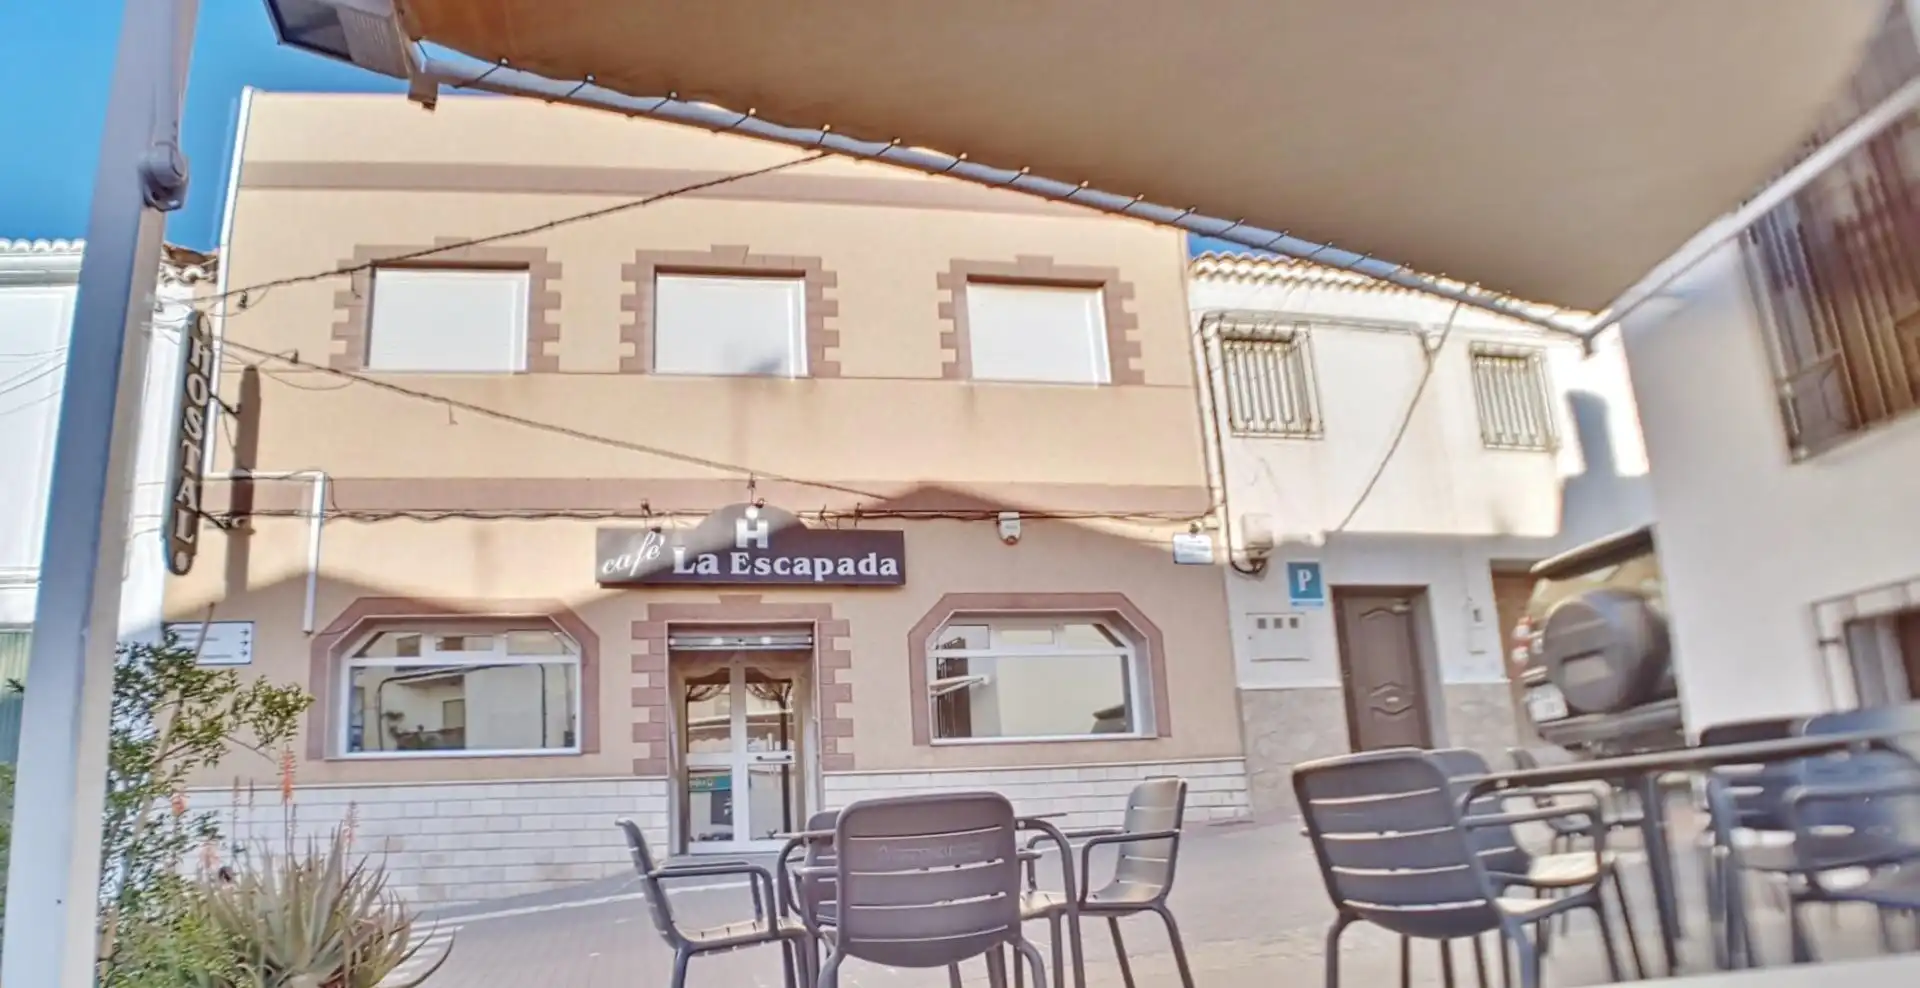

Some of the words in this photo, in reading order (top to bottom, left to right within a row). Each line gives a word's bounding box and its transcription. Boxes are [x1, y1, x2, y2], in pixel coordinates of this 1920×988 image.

[175, 337, 211, 544] HOSTAL
[671, 547, 720, 575] La
[730, 551, 898, 582] Escapada
[1296, 568, 1312, 592] P
